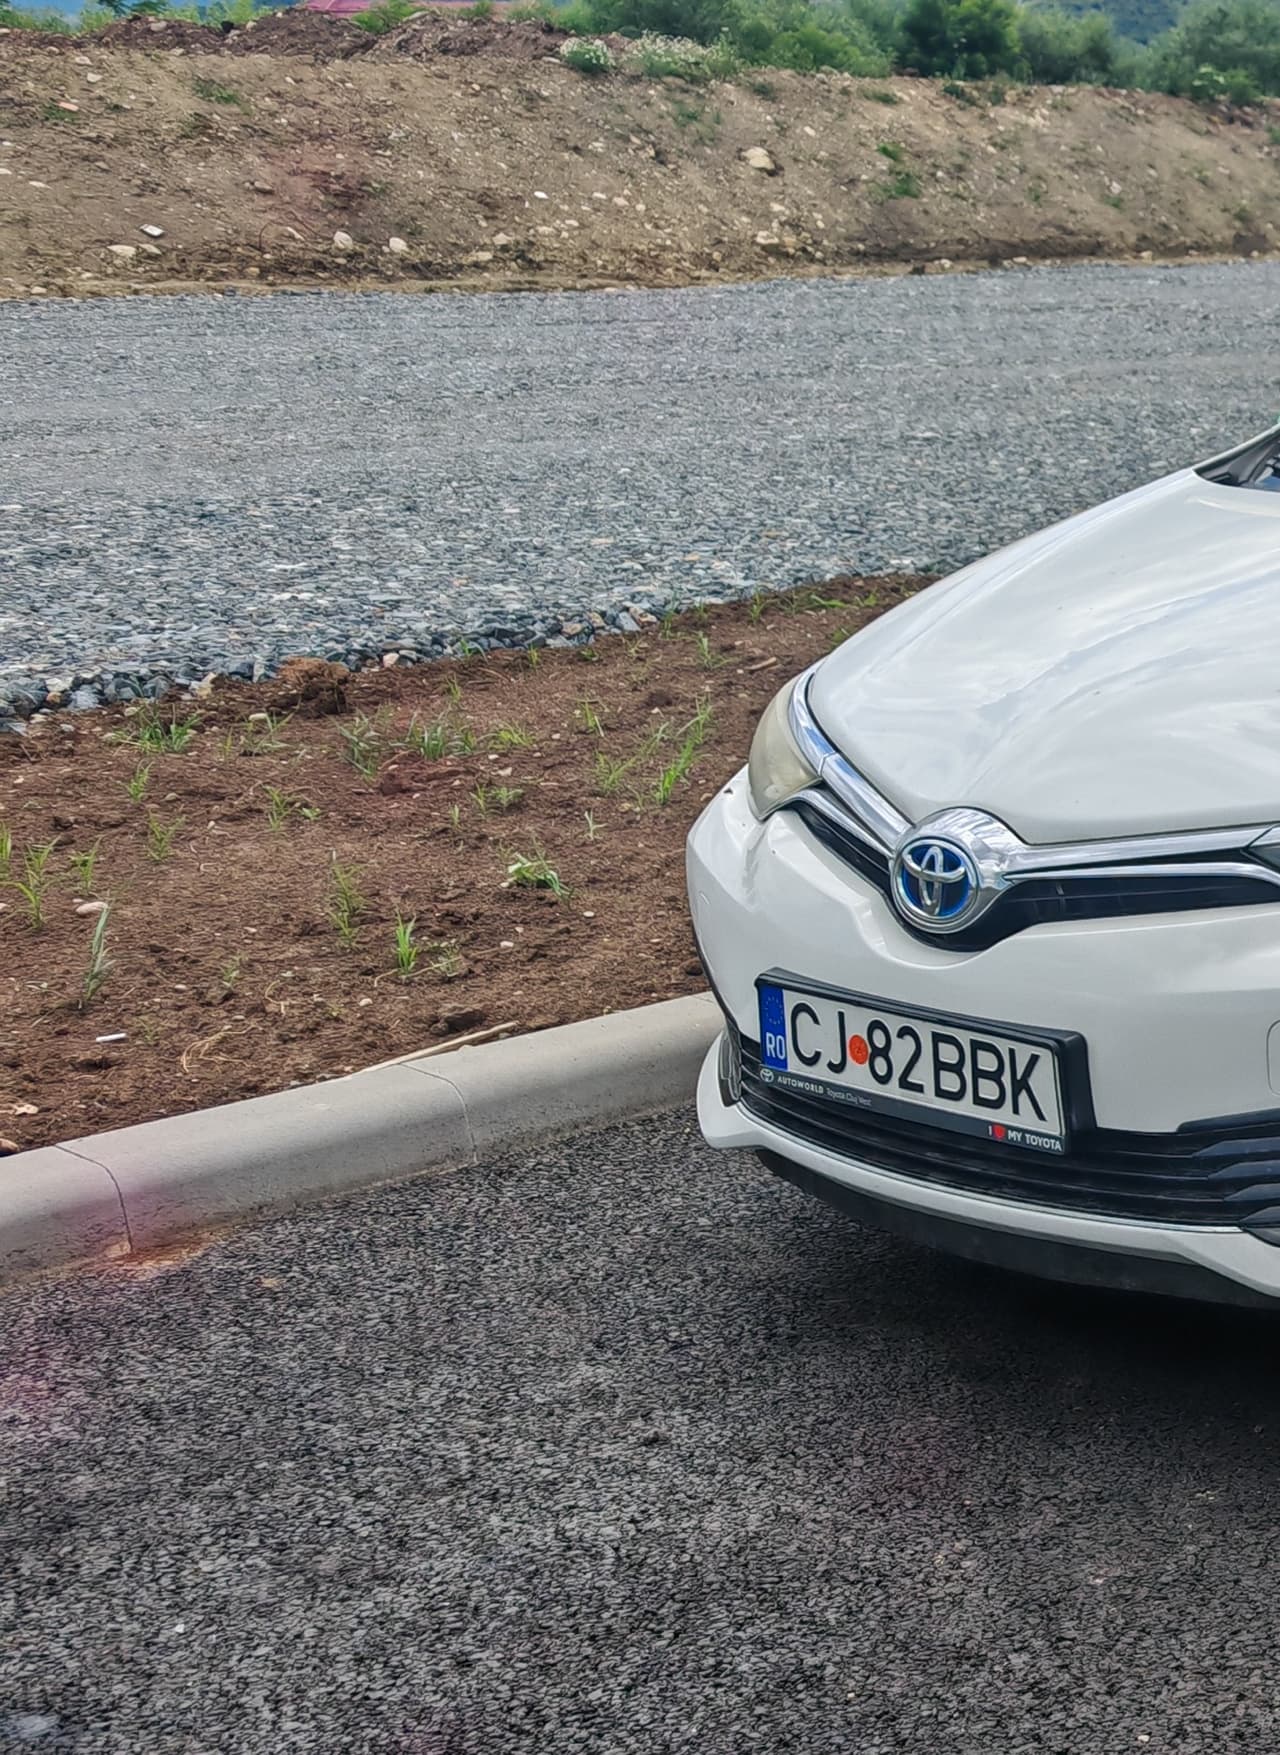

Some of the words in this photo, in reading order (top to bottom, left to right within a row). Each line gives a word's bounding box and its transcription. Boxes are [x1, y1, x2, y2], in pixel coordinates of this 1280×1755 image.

[766, 1031, 786, 1060] RO
[777, 1076, 824, 1094] AUTOWORLD
[988, 1125, 993, 1136] I
[1007, 1129, 1023, 1142] MY
[1024, 1133, 1063, 1152] TOYOTA
